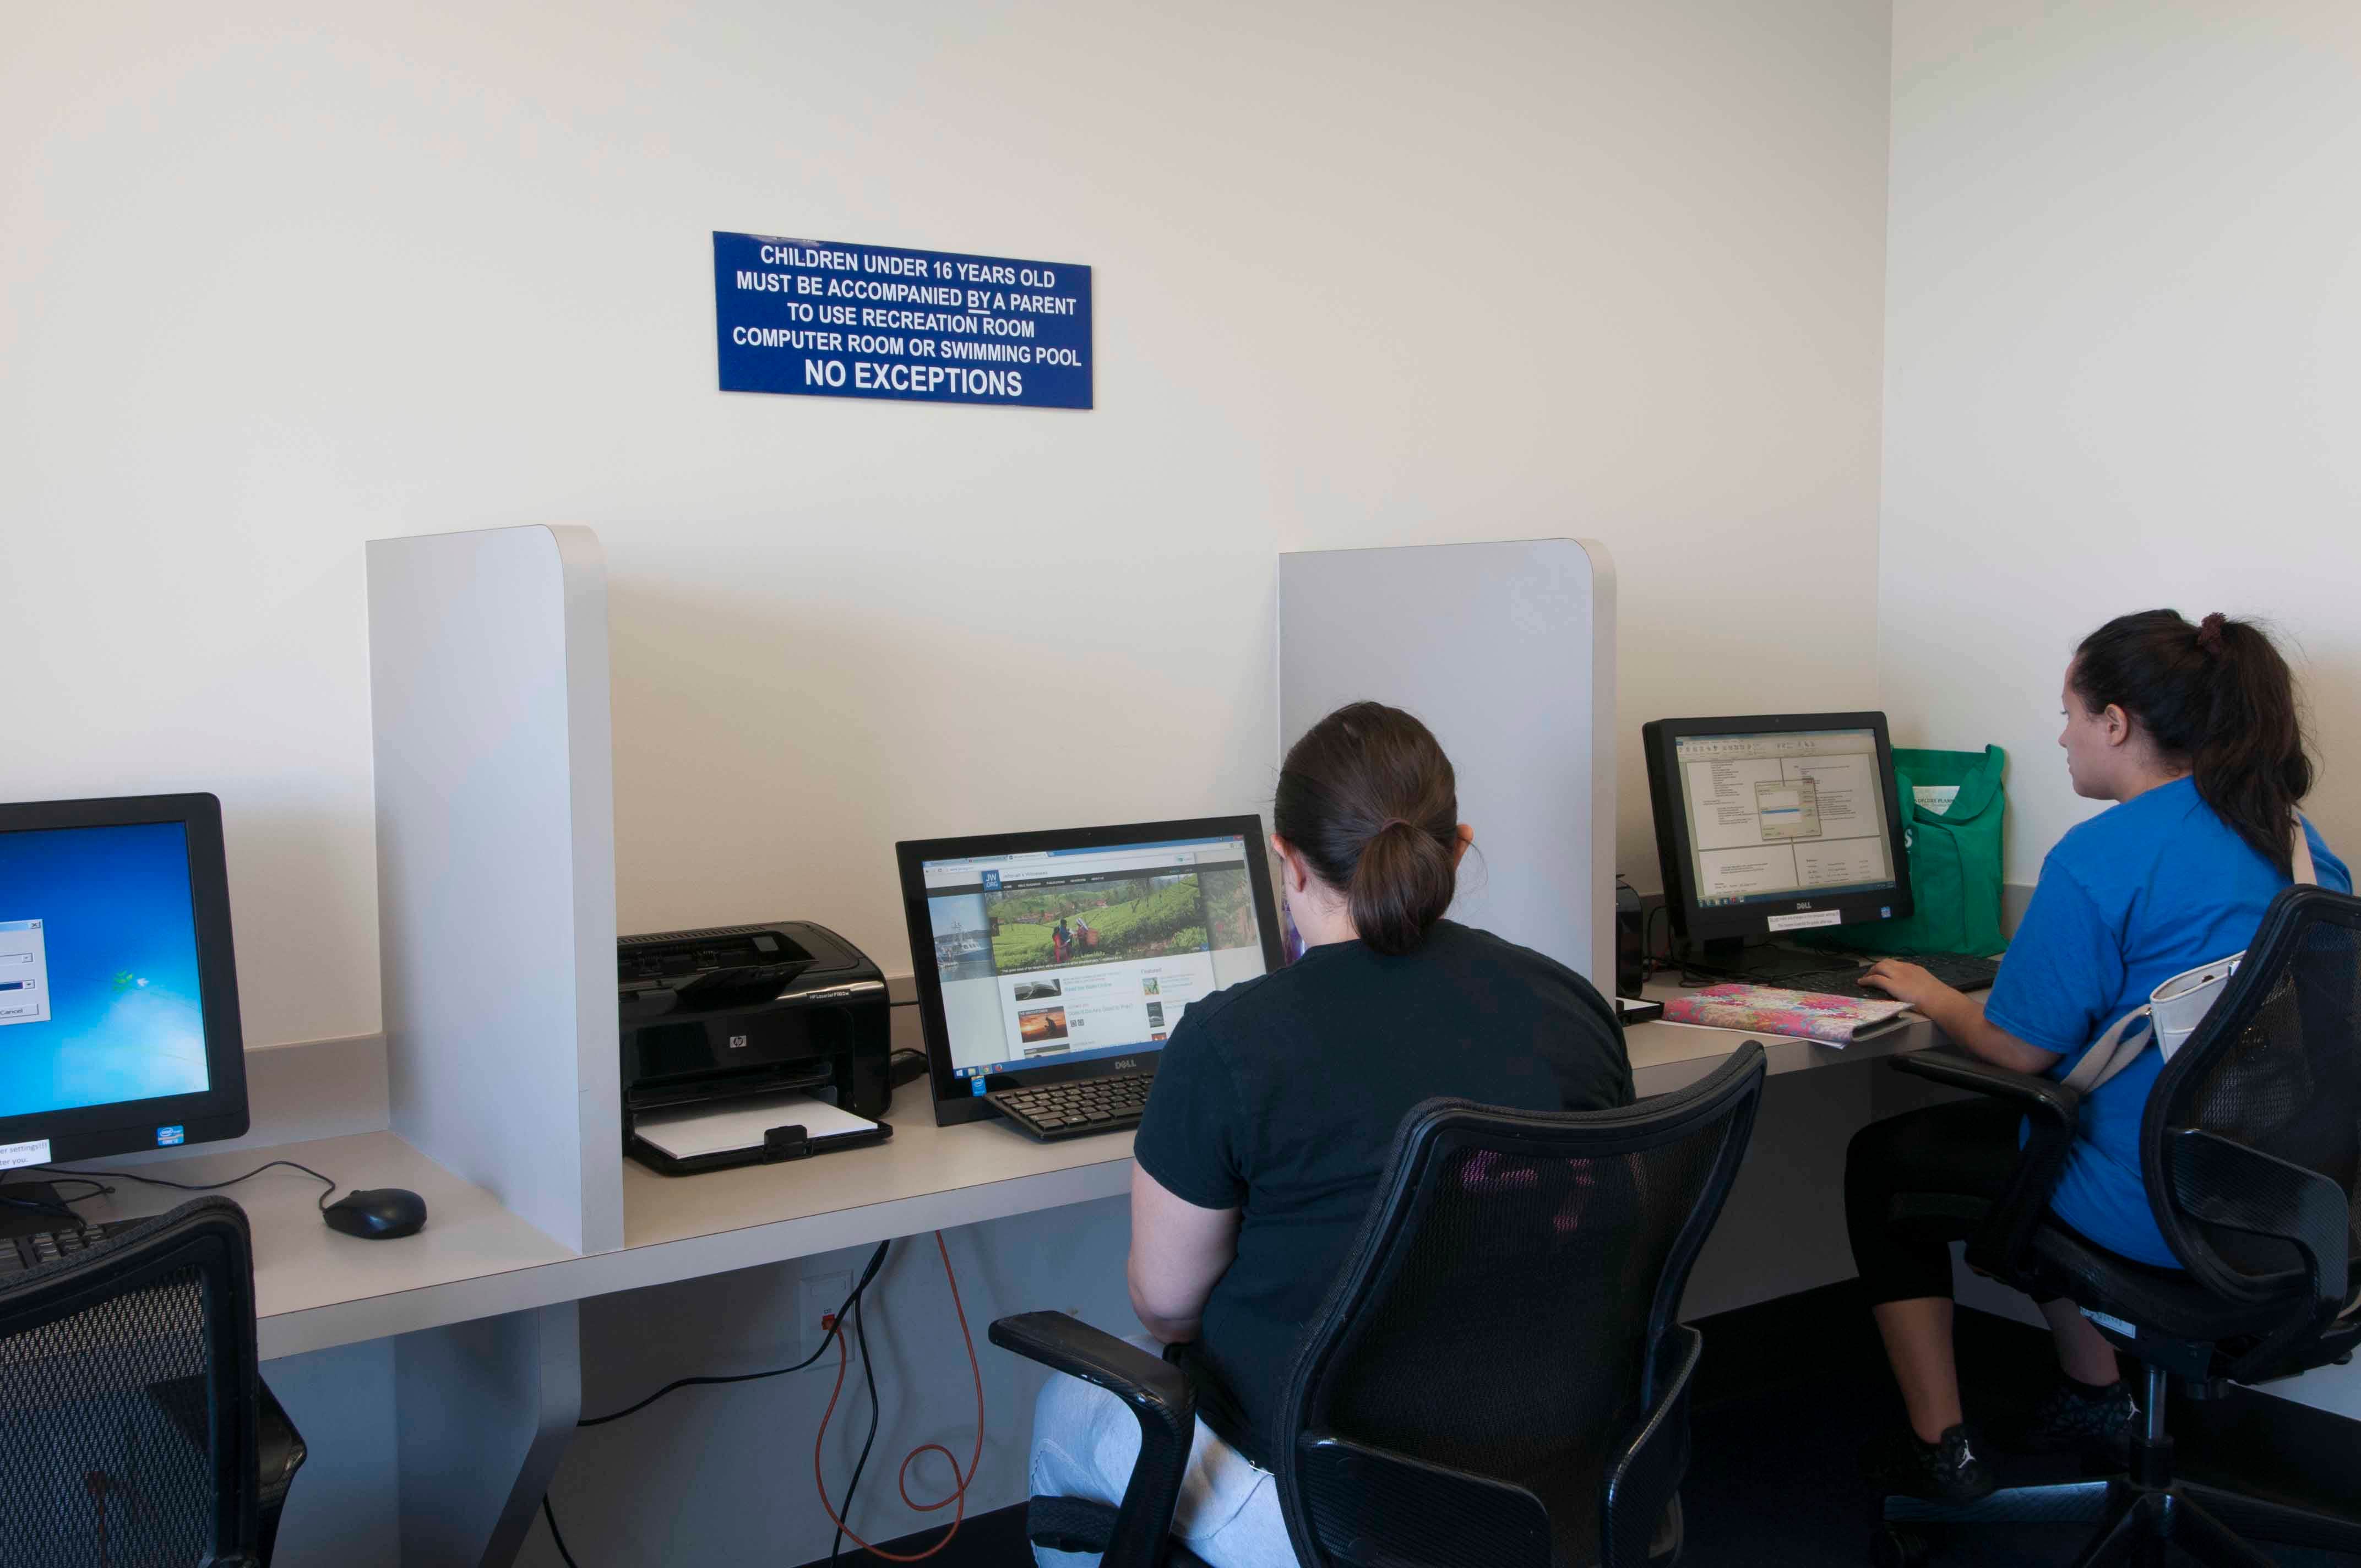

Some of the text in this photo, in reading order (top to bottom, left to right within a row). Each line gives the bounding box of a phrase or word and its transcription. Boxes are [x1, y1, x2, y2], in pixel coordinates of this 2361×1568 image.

[761, 246, 1055, 288] CHILDREN UNDER 16 YEARS OLD
[737, 271, 1076, 315] MUST BE ACCOMPANIED BY A PARENT
[787, 302, 1035, 337] TO USE RECREATION ROOM
[733, 326, 1081, 366] COMPUTER ROOM OR SWIMMING POOL
[805, 359, 1022, 396] NO EXCEPTIONS
[986, 873, 997, 882] JW
[1797, 902, 1812, 910] DELL
[1114, 1059, 1137, 1070] DELL
